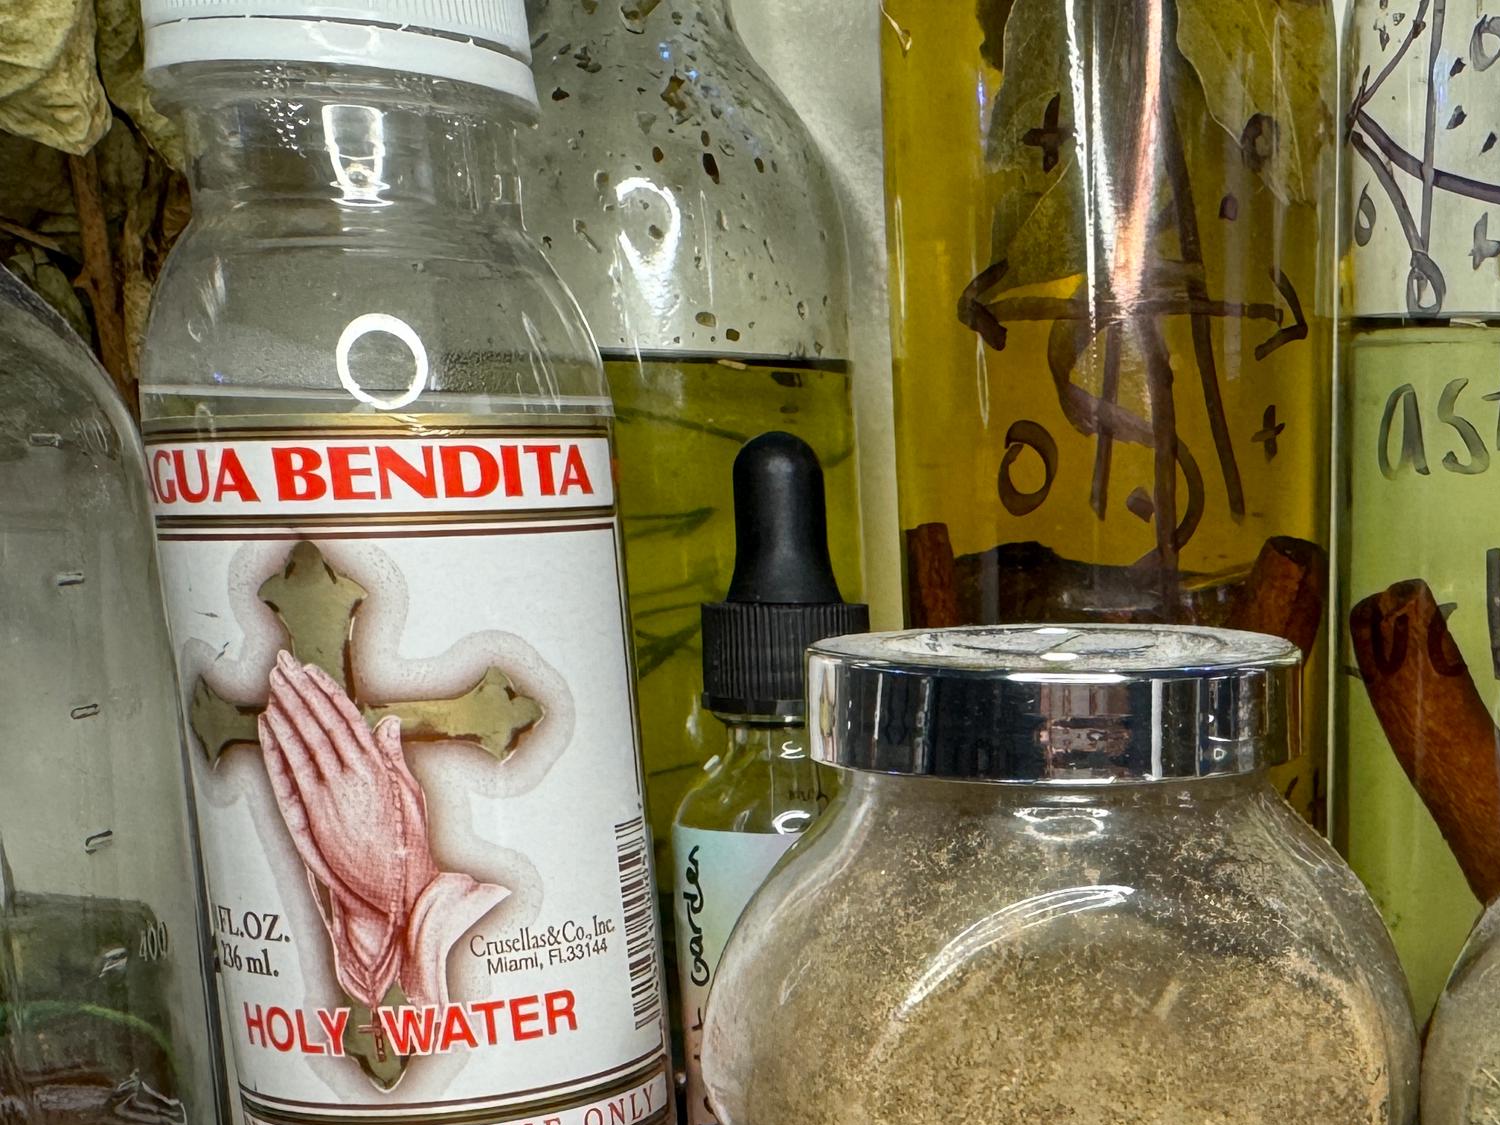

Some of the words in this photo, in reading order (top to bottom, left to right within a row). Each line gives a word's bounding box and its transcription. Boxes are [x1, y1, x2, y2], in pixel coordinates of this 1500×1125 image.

[271, 444, 594, 502] BENDITA
[245, 948, 280, 978] ml.
[487, 951, 544, 976] Miami,
[243, 1001, 349, 1057] HOLY
[381, 990, 577, 1056] WATER
